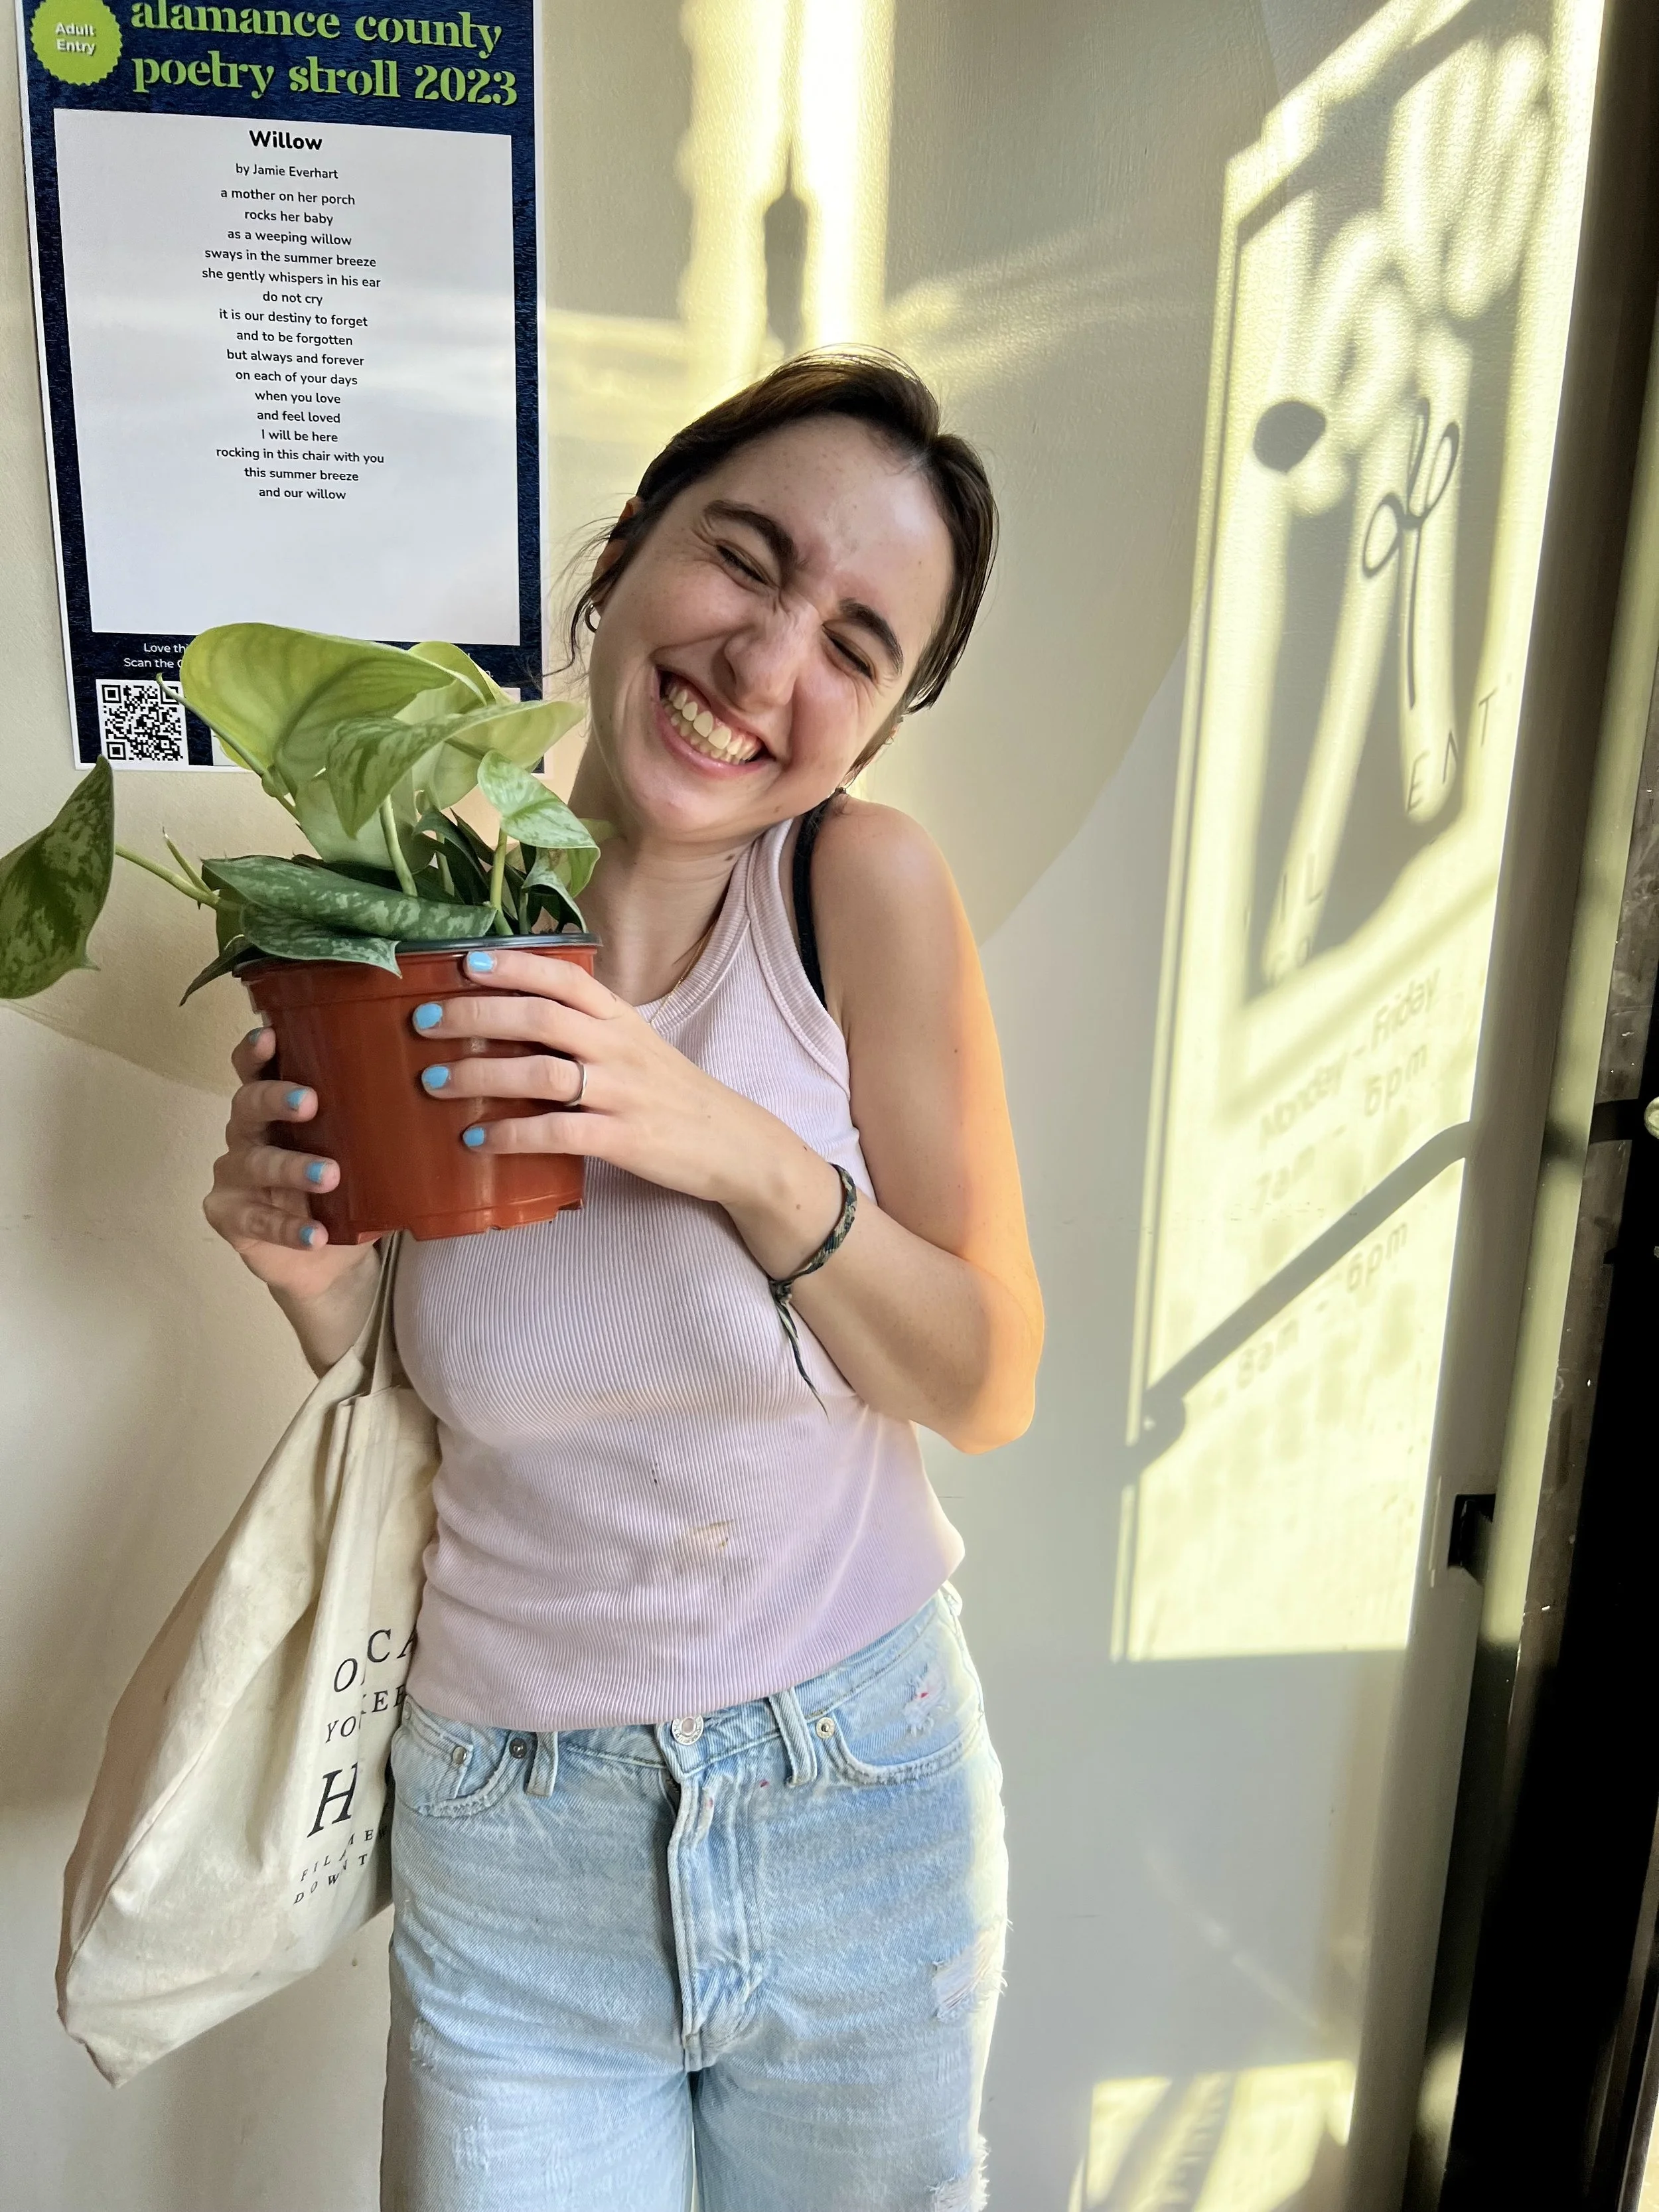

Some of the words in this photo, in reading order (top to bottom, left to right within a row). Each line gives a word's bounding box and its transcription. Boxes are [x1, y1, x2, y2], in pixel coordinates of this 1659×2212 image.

[55, 22, 94, 37] Adult
[131, 0, 340, 38] alamance
[354, 11, 502, 59] county
[56, 38, 96, 56] Entry
[131, 50, 275, 99] poetry
[289, 56, 401, 97] stroll
[415, 64, 518, 106] 2023
[248, 129, 323, 151] Willow
[236, 162, 250, 177] by
[252, 163, 286, 177] Jamie
[289, 165, 339, 180] Everhart
[220, 189, 228, 198] a
[231, 188, 277, 202] mother
[278, 192, 295, 202] on
[297, 191, 319, 203] her
[321, 194, 356, 207] porch
[244, 208, 277, 222] rocks
[279, 210, 301, 223] her
[303, 211, 334, 227] baby
[227, 230, 242, 240] as
[244, 232, 252, 240] a
[254, 230, 307, 246] weeping
[310, 233, 352, 246] willow
[204, 250, 244, 262] sways
[246, 248, 257, 261] in
[259, 250, 281, 262] the
[283, 254, 334, 265] summer
[335, 254, 377, 267] breeze
[202, 267, 224, 279] she
[226, 269, 265, 284] gently
[267, 271, 324, 286] whispers
[326, 273, 338, 285] in
[340, 274, 359, 287] his
[362, 278, 382, 288] ear
[262, 290, 278, 302] do
[281, 293, 303, 303] not
[305, 295, 323, 307] cry
[219, 307, 229, 320] it
[230, 309, 242, 321] is
[244, 312, 265, 321] our
[267, 311, 312, 327] destiny
[314, 313, 328, 325] to
[330, 314, 369, 329] forget
[236, 330, 259, 341] and
[261, 331, 275, 342] to
[277, 331, 293, 343] be
[295, 332, 353, 346] forgotten
[226, 348, 248, 360] but
[250, 350, 293, 365] always
[296, 352, 319, 364] and
[321, 353, 365, 366] forever
[235, 372, 251, 380] on
[253, 370, 281, 382] each
[285, 372, 298, 382] of
[300, 374, 328, 386] your
[330, 374, 358, 388] days
[254, 390, 288, 402] when
[290, 394, 313, 405] you
[315, 392, 341, 404] love
[257, 409, 279, 421] and
[281, 410, 306, 422] feel
[307, 411, 341, 423] loved
[261, 429, 265, 440] I
[268, 429, 292, 441] will
[293, 430, 309, 441] be
[311, 431, 338, 443] here
[216, 447, 260, 461] rocking
[262, 447, 274, 459] in
[276, 449, 299, 460] this
[302, 450, 331, 461] chair
[332, 451, 360, 463] with
[362, 455, 385, 465] you
[244, 467, 267, 478] this
[269, 470, 317, 480] summer
[319, 469, 359, 482] breeze
[258, 486, 281, 498] and
[283, 490, 304, 498] our
[306, 488, 346, 500] willow
[143, 643, 171, 653] Love
[173, 644, 188, 653] th
[123, 658, 152, 668] Scan
[155, 659, 174, 668] the
